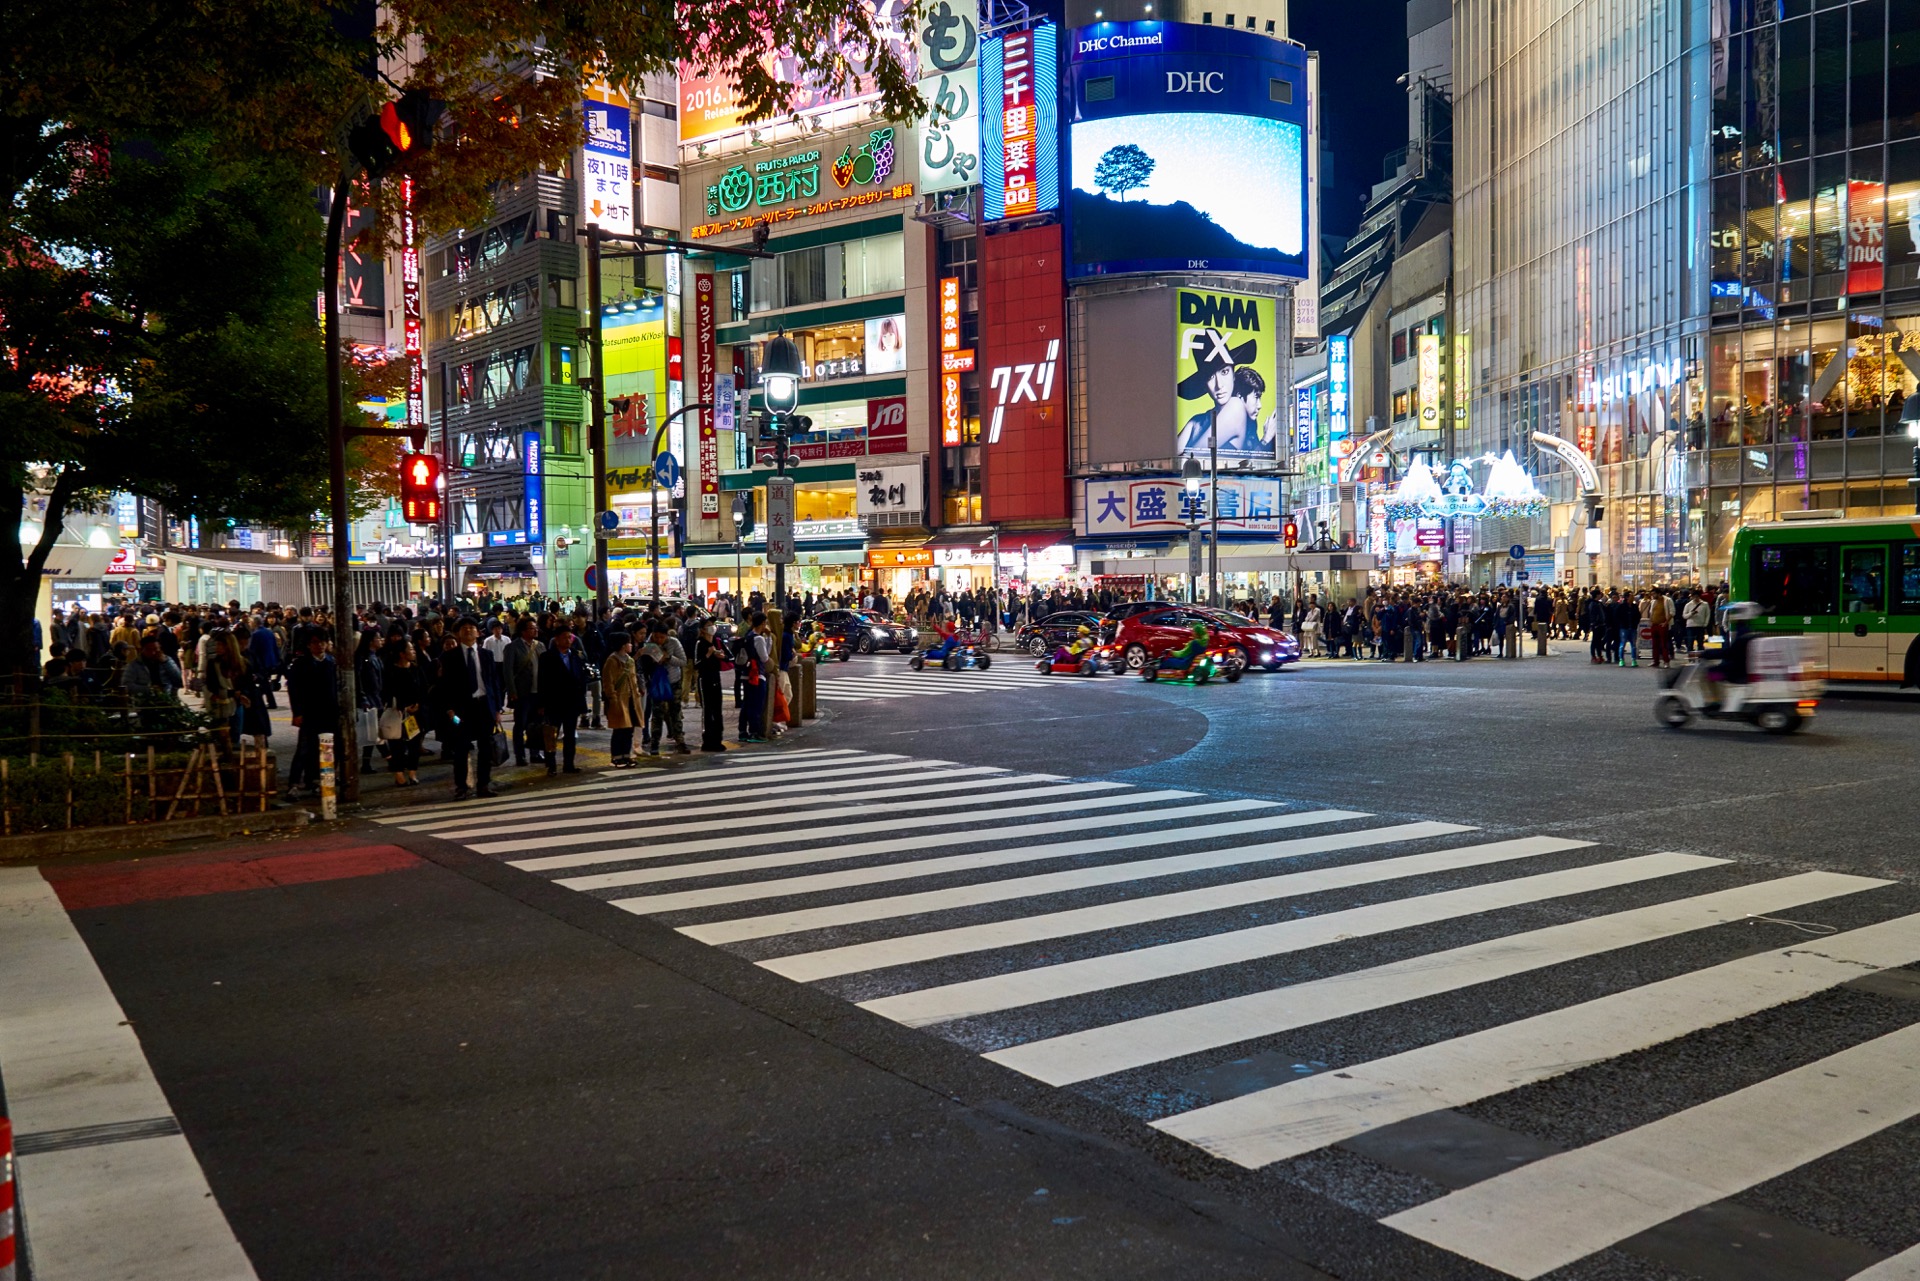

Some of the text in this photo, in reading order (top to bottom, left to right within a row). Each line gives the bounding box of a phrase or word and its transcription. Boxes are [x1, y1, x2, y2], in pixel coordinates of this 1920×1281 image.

[1079, 33, 1162, 53] DHC Channel
[919, 2, 976, 181] もんじゃ
[1166, 71, 1224, 94] DHC
[1003, 36, 1031, 205] 三千里薬品
[587, 158, 629, 181] 夜11時
[597, 178, 621, 195] まで
[756, 164, 820, 206] 西村
[606, 205, 630, 221] 地下
[707, 184, 718, 216] 渋谷
[1187, 260, 1209, 269] DHC
[1180, 292, 1260, 331] DMM
[1296, 308, 1315, 316] 3719
[1180, 328, 1234, 364] FX
[988, 339, 1060, 443] クスリ
[1330, 341, 1347, 432] 洋服の青山
[871, 402, 905, 431] JTB
[529, 440, 539, 474] MIZUHO
[832, 441, 862, 452] ハネムーン
[529, 498, 538, 535] みずほ銀行
[771, 485, 785, 555] 道玄坂
[1096, 487, 1273, 523] 大盛堂書店
